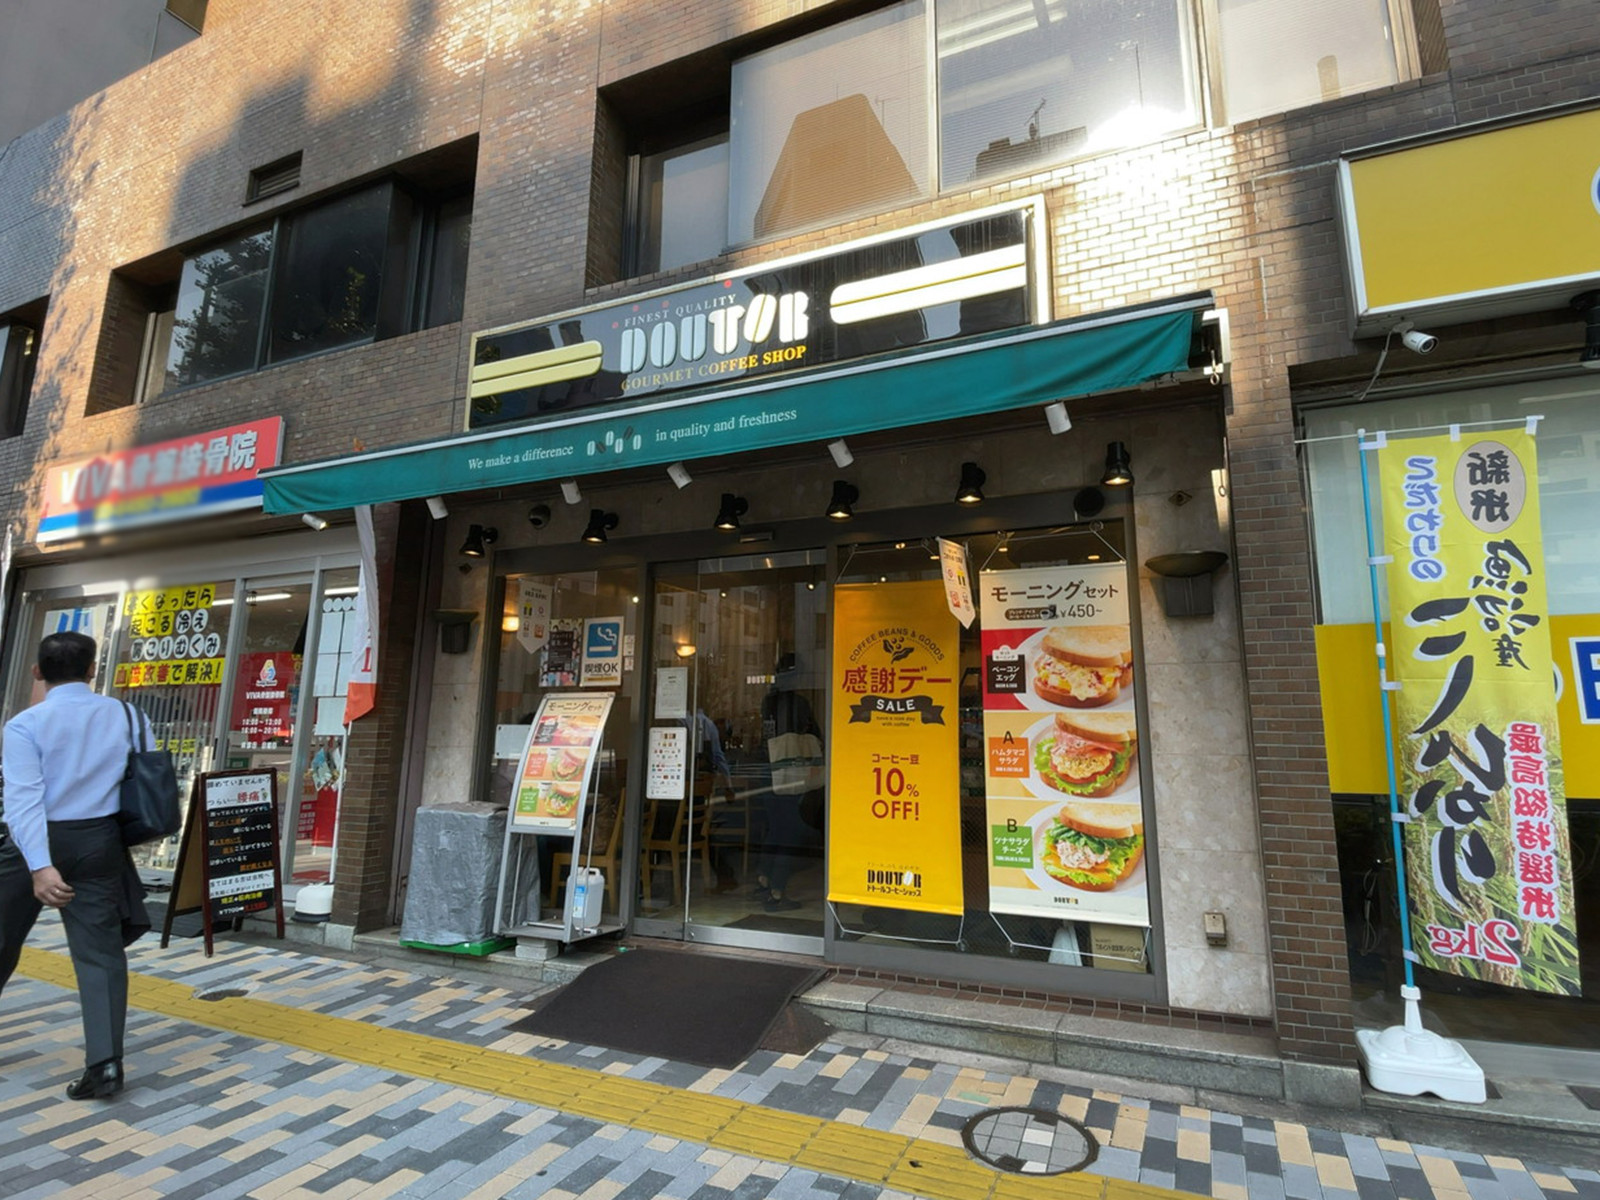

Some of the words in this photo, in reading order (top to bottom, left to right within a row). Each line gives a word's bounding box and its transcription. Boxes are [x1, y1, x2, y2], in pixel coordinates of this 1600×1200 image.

[624, 310, 669, 327] FINEST
[675, 293, 737, 316] QUALITY
[620, 291, 810, 375] DOUTOR
[621, 367, 694, 391] GOURMET
[698, 355, 758, 376] COFFEE
[762, 345, 807, 366] SHOP
[655, 429, 667, 441] in
[670, 422, 710, 442] quality
[713, 417, 735, 432] and
[738, 409, 797, 429] freshness
[468, 457, 484, 470] We
[485, 453, 512, 468] make
[513, 455, 520, 463] a
[522, 445, 574, 462] difference
[991, 579, 1119, 602] モーニングセット
[849, 633, 877, 661] COFFEE
[878, 628, 908, 638] BEANS
[911, 630, 916, 638] &
[919, 634, 945, 661] GOODS
[992, 665, 1020, 673] ベーコン
[996, 673, 1017, 682] エッグ
[842, 665, 952, 693] 感謝デー
[876, 699, 915, 712] SALE
[1003, 730, 1015, 744] A
[872, 753, 920, 765] コーヒー豆
[991, 748, 1026, 757] ハムタマゴ
[998, 757, 1019, 765] サラダ
[872, 767, 919, 797] 10%
[871, 799, 919, 821] OFF!
[1007, 818, 1018, 833] B
[994, 836, 1031, 846] ツナサラダ
[1002, 845, 1024, 855] チーズ
[867, 869, 921, 888] DOUTOR
